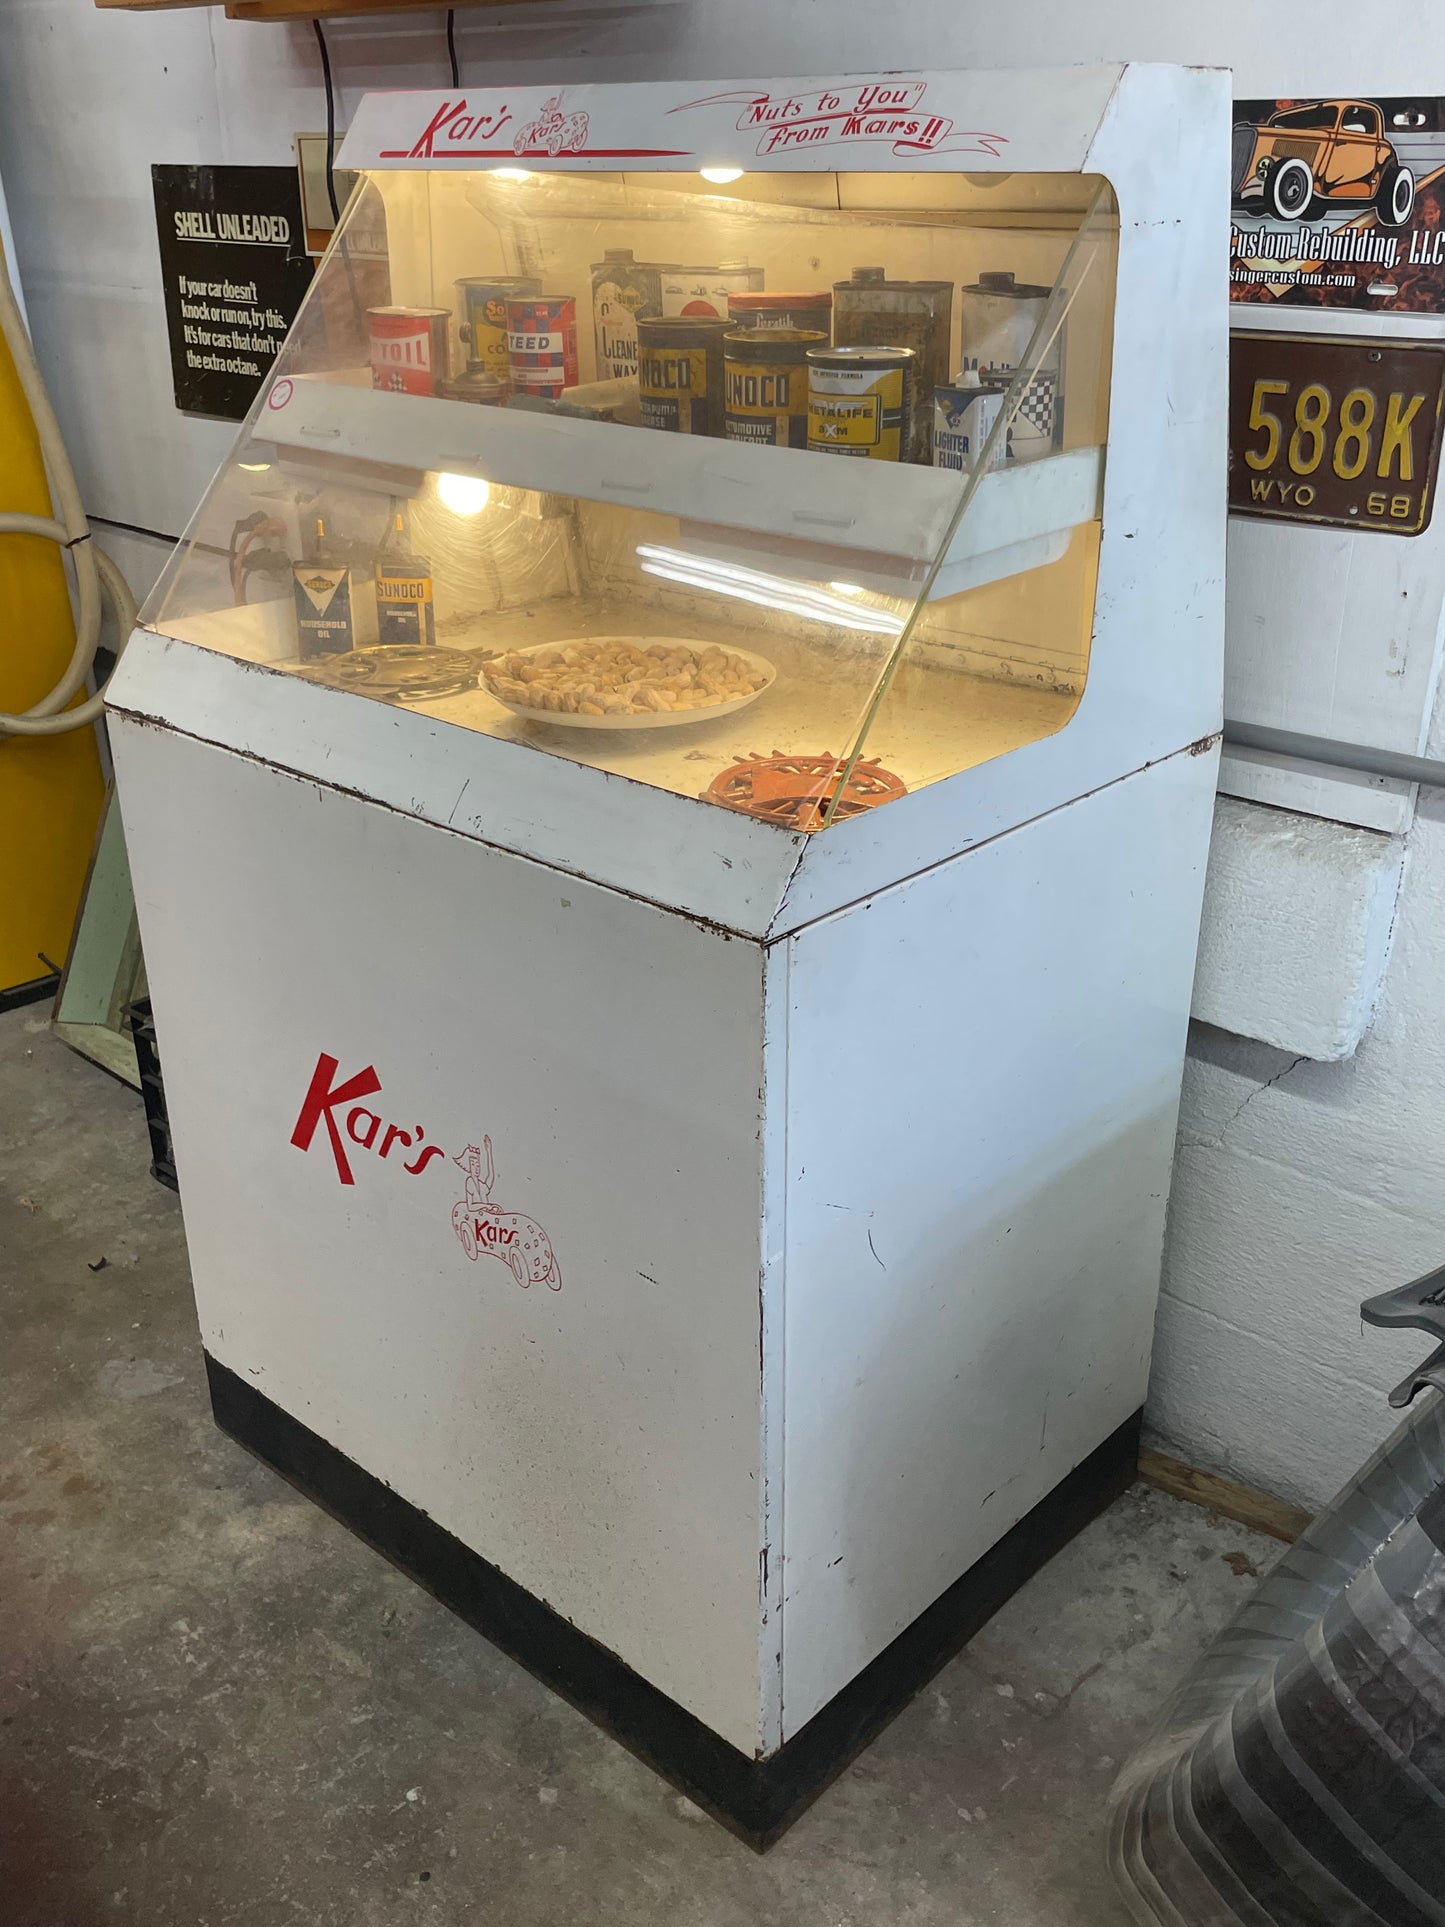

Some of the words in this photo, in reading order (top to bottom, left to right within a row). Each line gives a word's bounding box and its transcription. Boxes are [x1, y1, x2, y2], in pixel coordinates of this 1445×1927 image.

[817, 92, 840, 112] to
[407, 98, 512, 158] Kar's
[174, 211, 217, 239] SHELL
[216, 213, 290, 243] UNLEADED
[1295, 226, 1401, 270] Rebuilding,
[179, 275, 187, 295] If
[187, 280, 208, 298] your
[208, 283, 223, 297] car
[223, 279, 258, 301] doesn't
[1229, 267, 1356, 287] singercustom.com
[181, 299, 211, 320] knock
[211, 307, 221, 322] or
[221, 308, 238, 324] run
[237, 309, 252, 329] on,
[251, 308, 265, 330] try
[266, 308, 288, 330] this.
[184, 325, 198, 344] It's
[198, 327, 212, 346] for
[212, 331, 232, 348] cars
[231, 331, 252, 351] that
[251, 333, 276, 354] don't
[186, 350, 202, 368] the
[202, 353, 227, 372] extra
[227, 357, 261, 377] octane.
[640, 357, 692, 390] NOCO
[727, 372, 790, 408] UNOCO
[935, 430, 970, 454] LIGHTER
[1244, 380, 1425, 481] 588K
[938, 451, 963, 472] FLUID
[1250, 479, 1315, 507] WYO
[1366, 490, 1411, 519] 68
[376, 581, 424, 599] SUNOCO
[290, 1051, 445, 1186] Kar's
[474, 1218, 519, 1248] Kars
